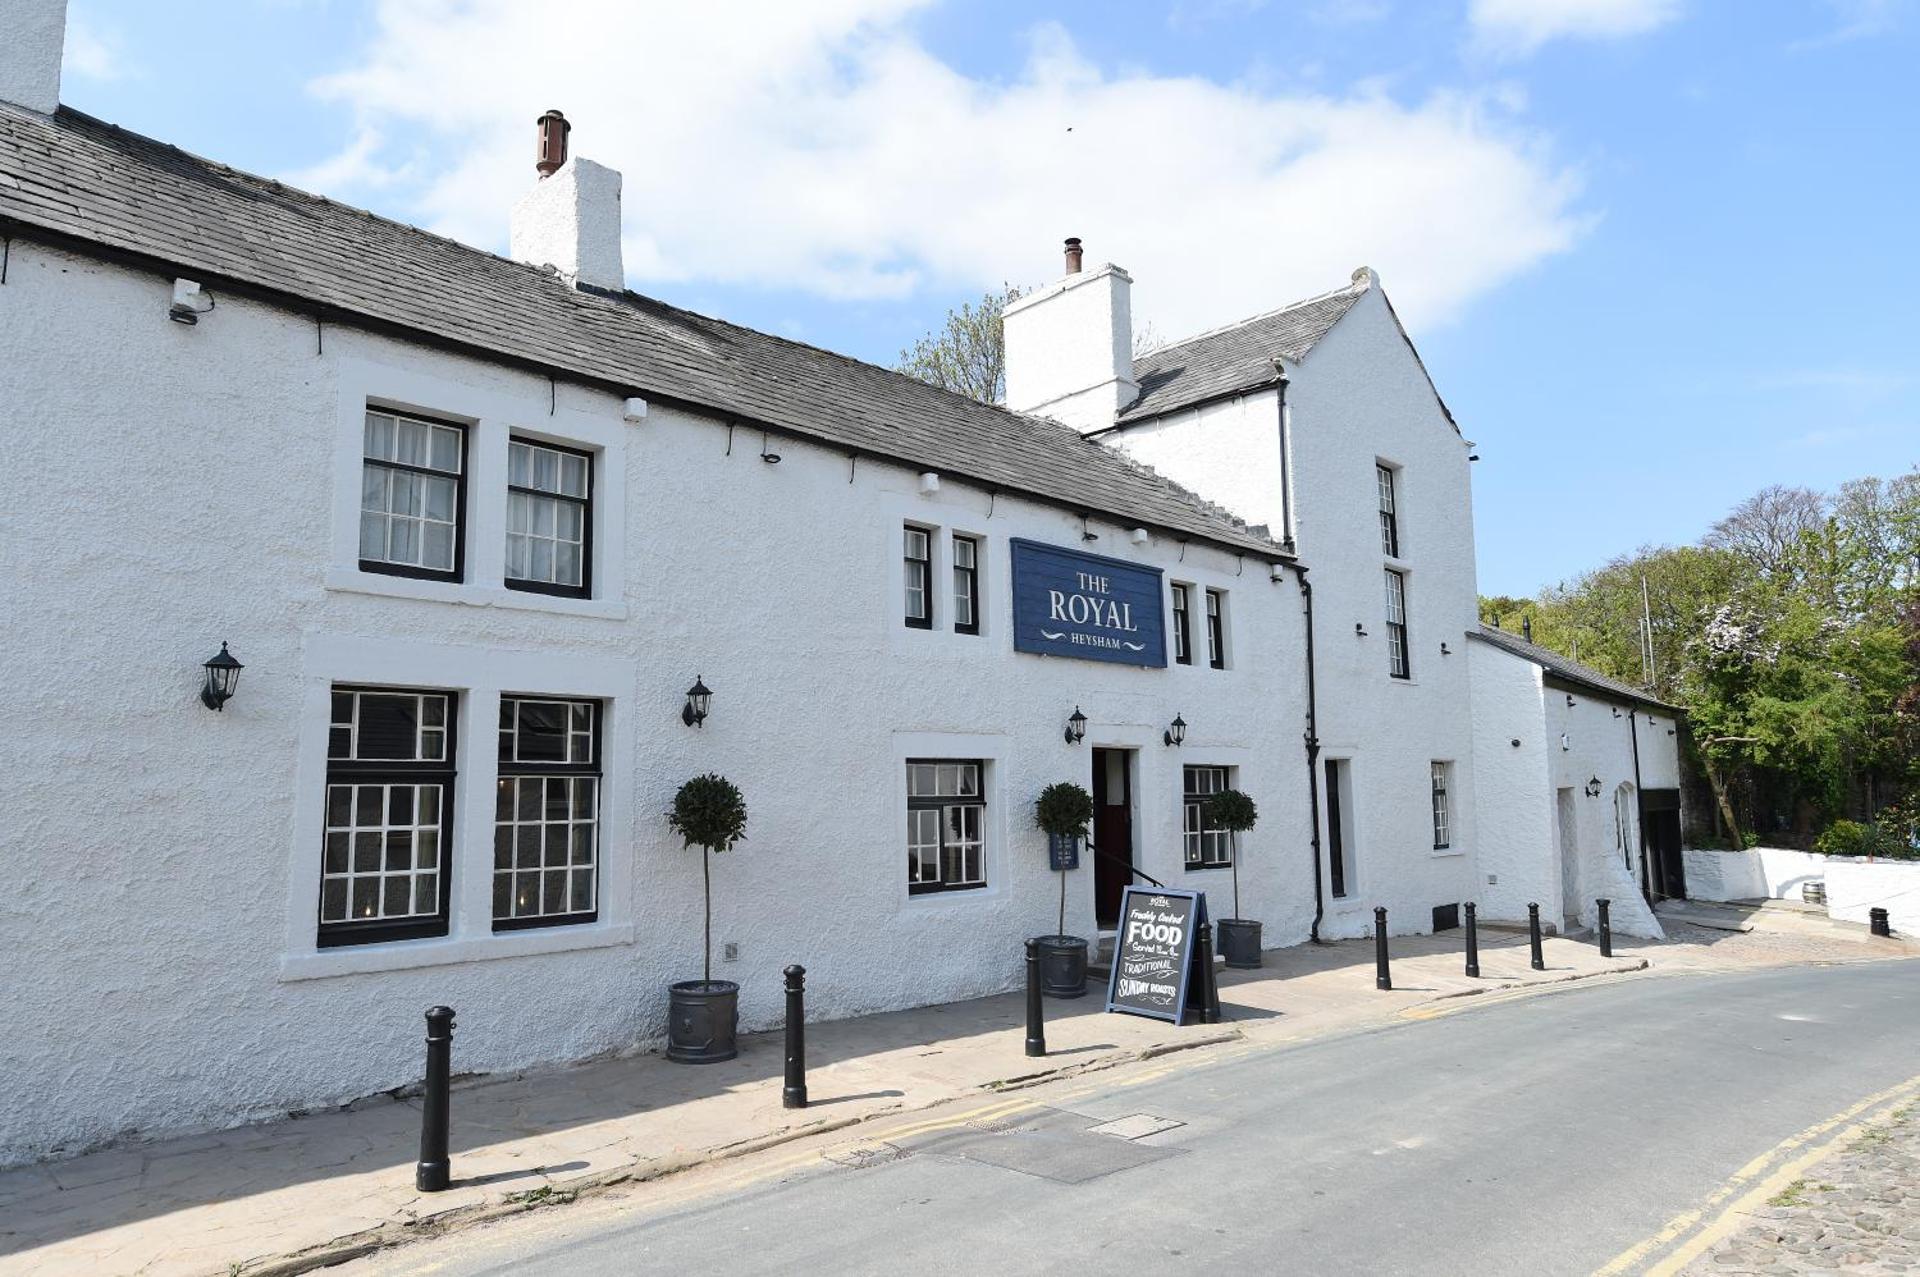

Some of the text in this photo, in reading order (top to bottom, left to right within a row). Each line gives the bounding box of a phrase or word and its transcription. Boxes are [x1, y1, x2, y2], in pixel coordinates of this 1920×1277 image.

[1076, 571, 1110, 594] THE
[1048, 590, 1137, 632] ROYAL
[1071, 632, 1121, 650] HEYSHAM
[1126, 921, 1183, 946] FOOD
[1132, 941, 1156, 953] Served
[1124, 959, 1172, 975] TRADITIONAL
[1118, 978, 1150, 998] SUNDAY
